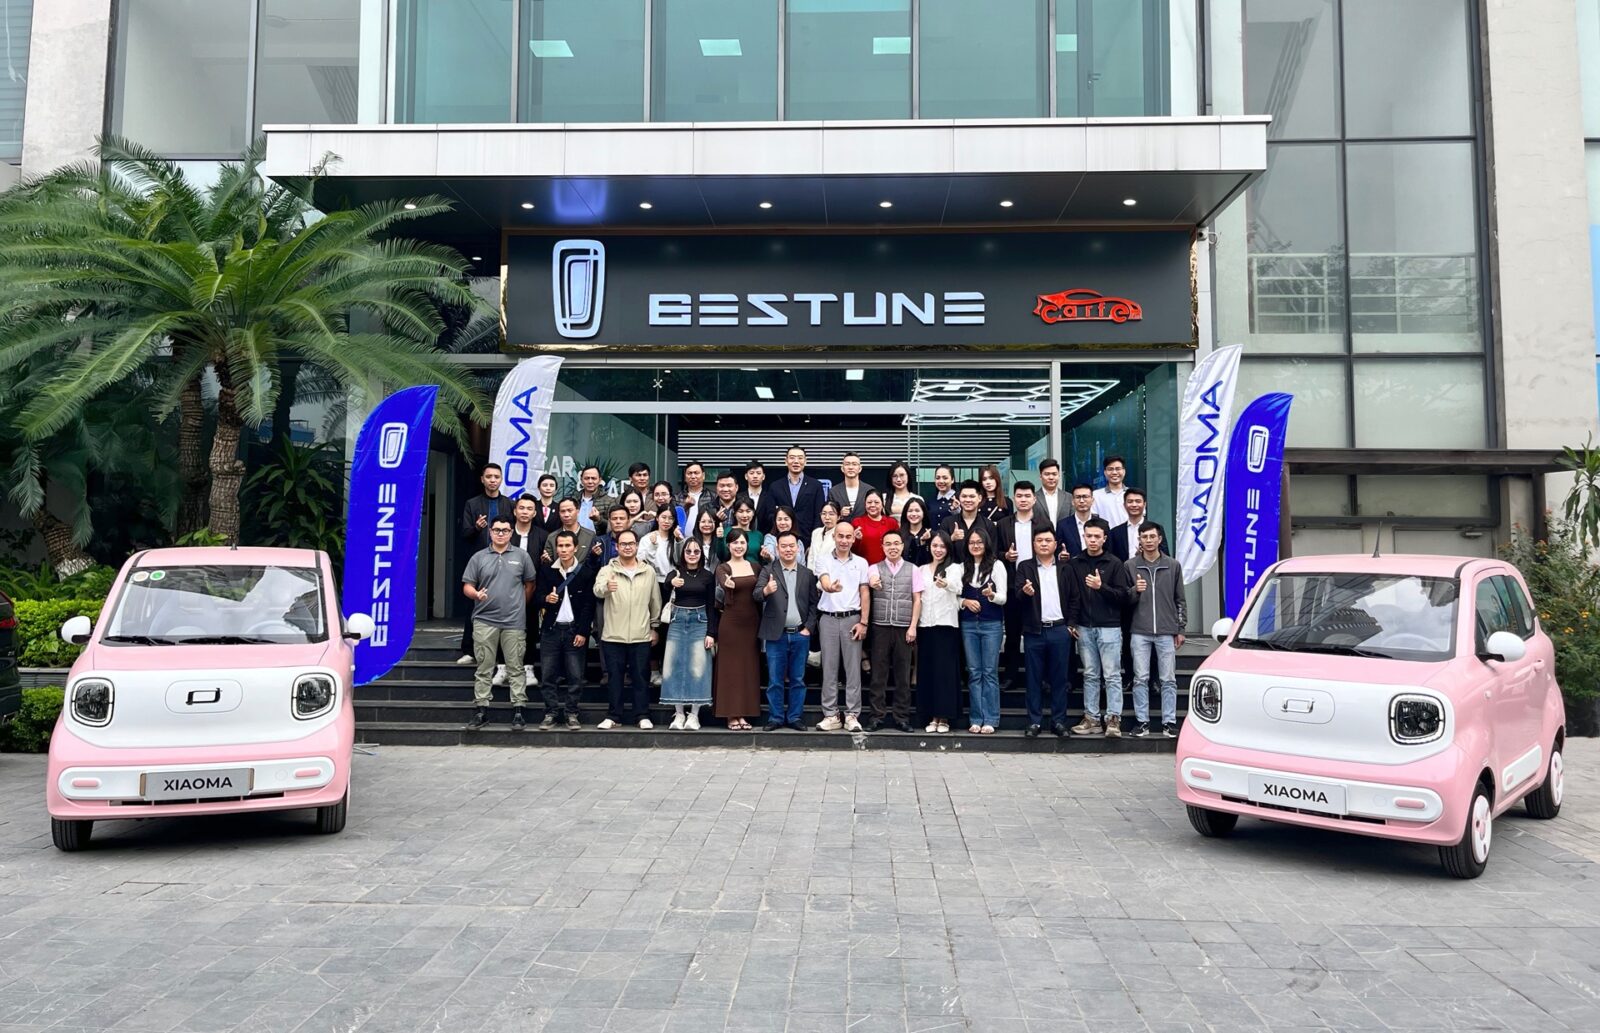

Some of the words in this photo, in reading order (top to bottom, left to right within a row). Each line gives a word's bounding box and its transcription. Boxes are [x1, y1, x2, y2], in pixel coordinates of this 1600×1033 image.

[649, 292, 985, 325] BESTUNE
[505, 386, 538, 500] OMA
[545, 455, 574, 478] AR
[1245, 488, 1260, 604] TUNE
[370, 484, 397, 647] BESTUNE
[163, 777, 233, 791] XIAOMA
[1263, 783, 1328, 804] XIAOMA
